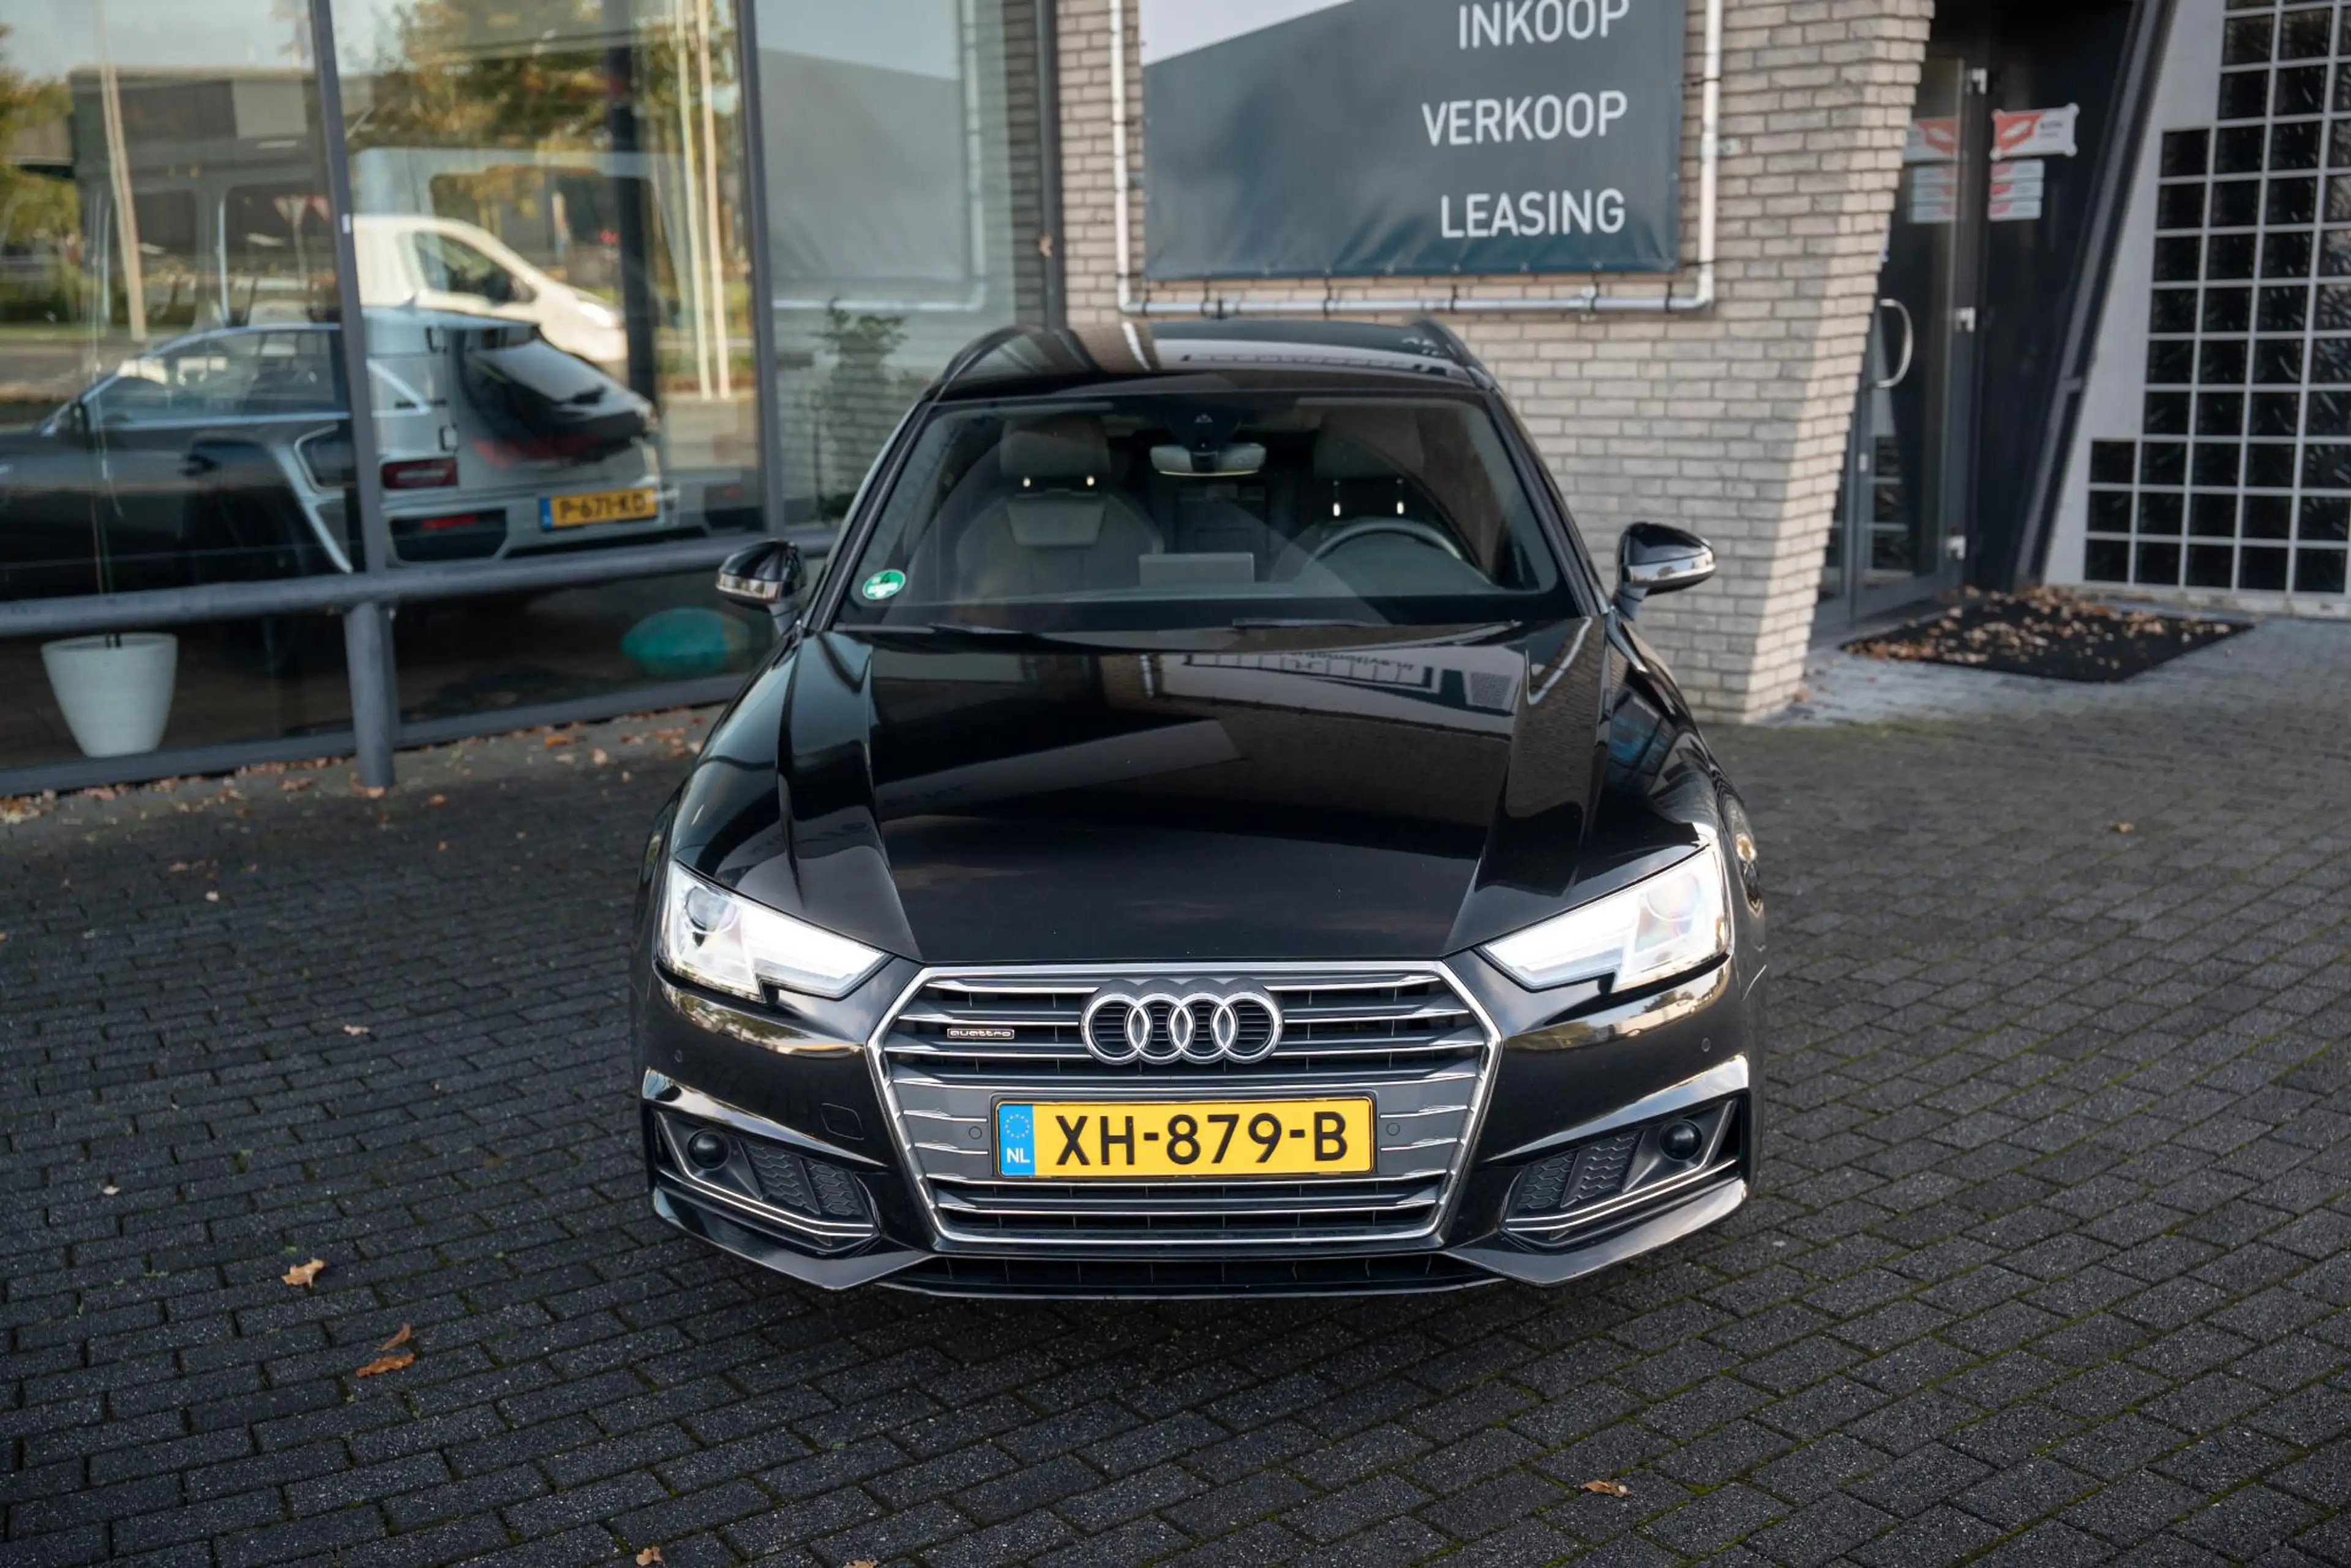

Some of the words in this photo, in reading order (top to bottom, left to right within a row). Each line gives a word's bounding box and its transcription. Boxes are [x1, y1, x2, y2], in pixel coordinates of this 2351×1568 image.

[1459, 0, 1630, 50] INKOOP
[1421, 90, 1627, 146] VERKOOP
[1441, 188, 1625, 238] LEASING
[1007, 1148, 1030, 1163] NL
[1056, 1111, 1348, 1166] XH-879-B
